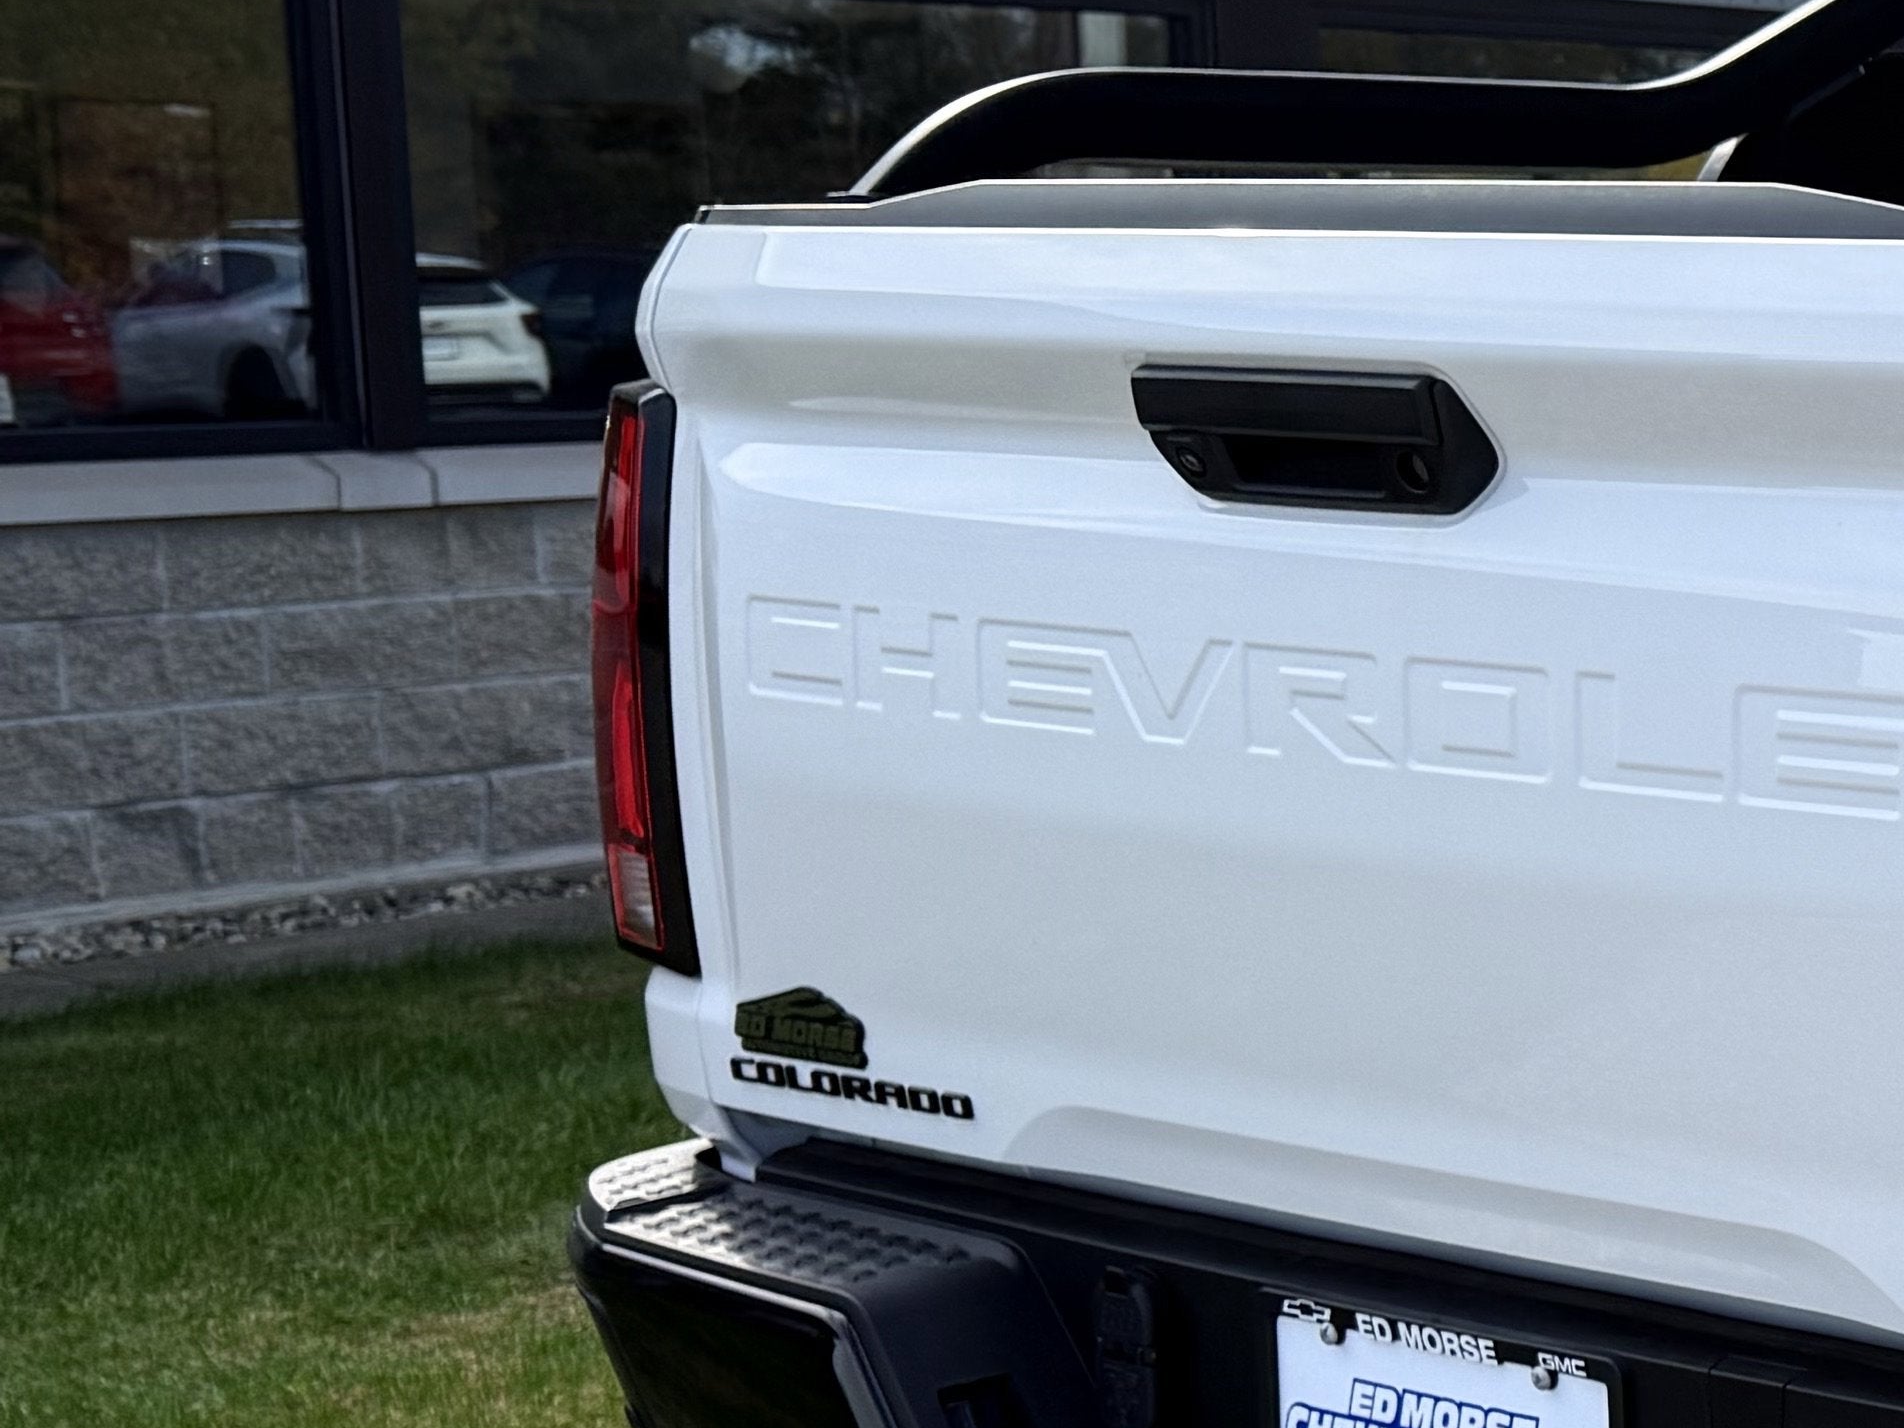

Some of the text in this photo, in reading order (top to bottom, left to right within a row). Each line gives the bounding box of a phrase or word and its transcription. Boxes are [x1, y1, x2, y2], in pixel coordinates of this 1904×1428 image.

[730, 1056, 975, 1120] COLORADO
[1356, 1312, 1586, 1376] ED MORSE GMC
[1351, 1379, 1399, 1423] ED
